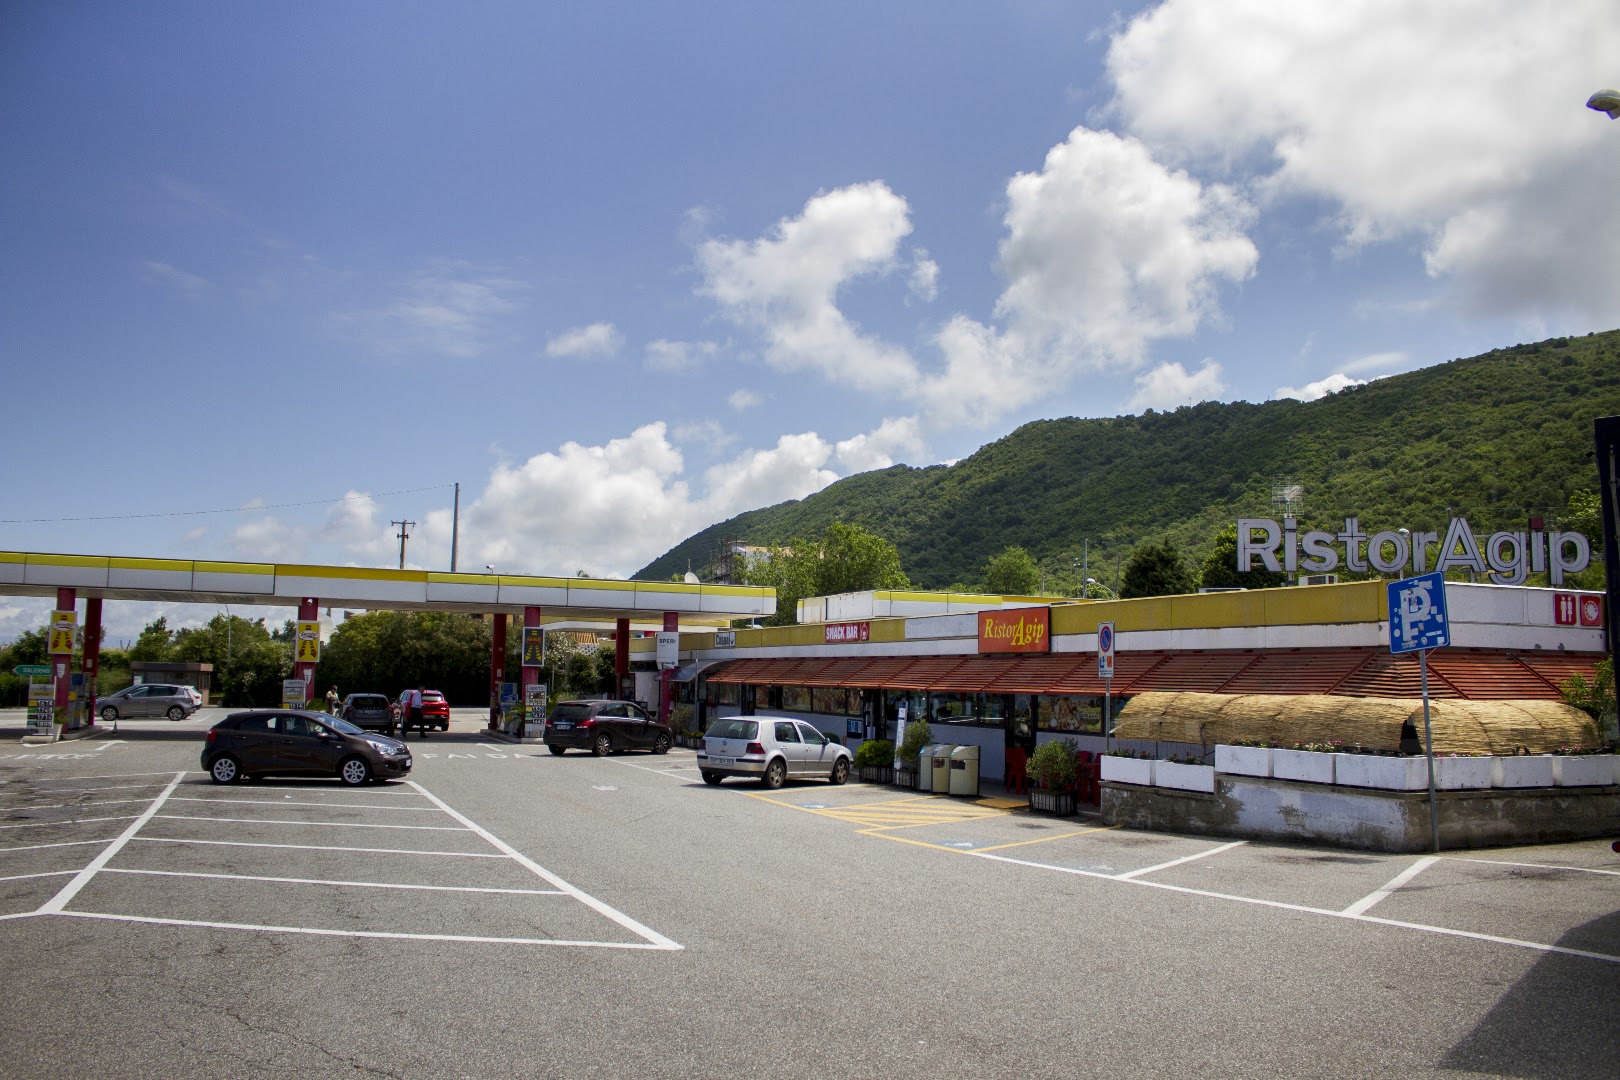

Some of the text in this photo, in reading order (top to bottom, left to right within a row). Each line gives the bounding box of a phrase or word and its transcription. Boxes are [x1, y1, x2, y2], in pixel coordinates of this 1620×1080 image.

[1237, 517, 1591, 585] RistorAgip
[826, 625, 859, 640] SNACK BAR
[984, 616, 1044, 646] RistorAgip
